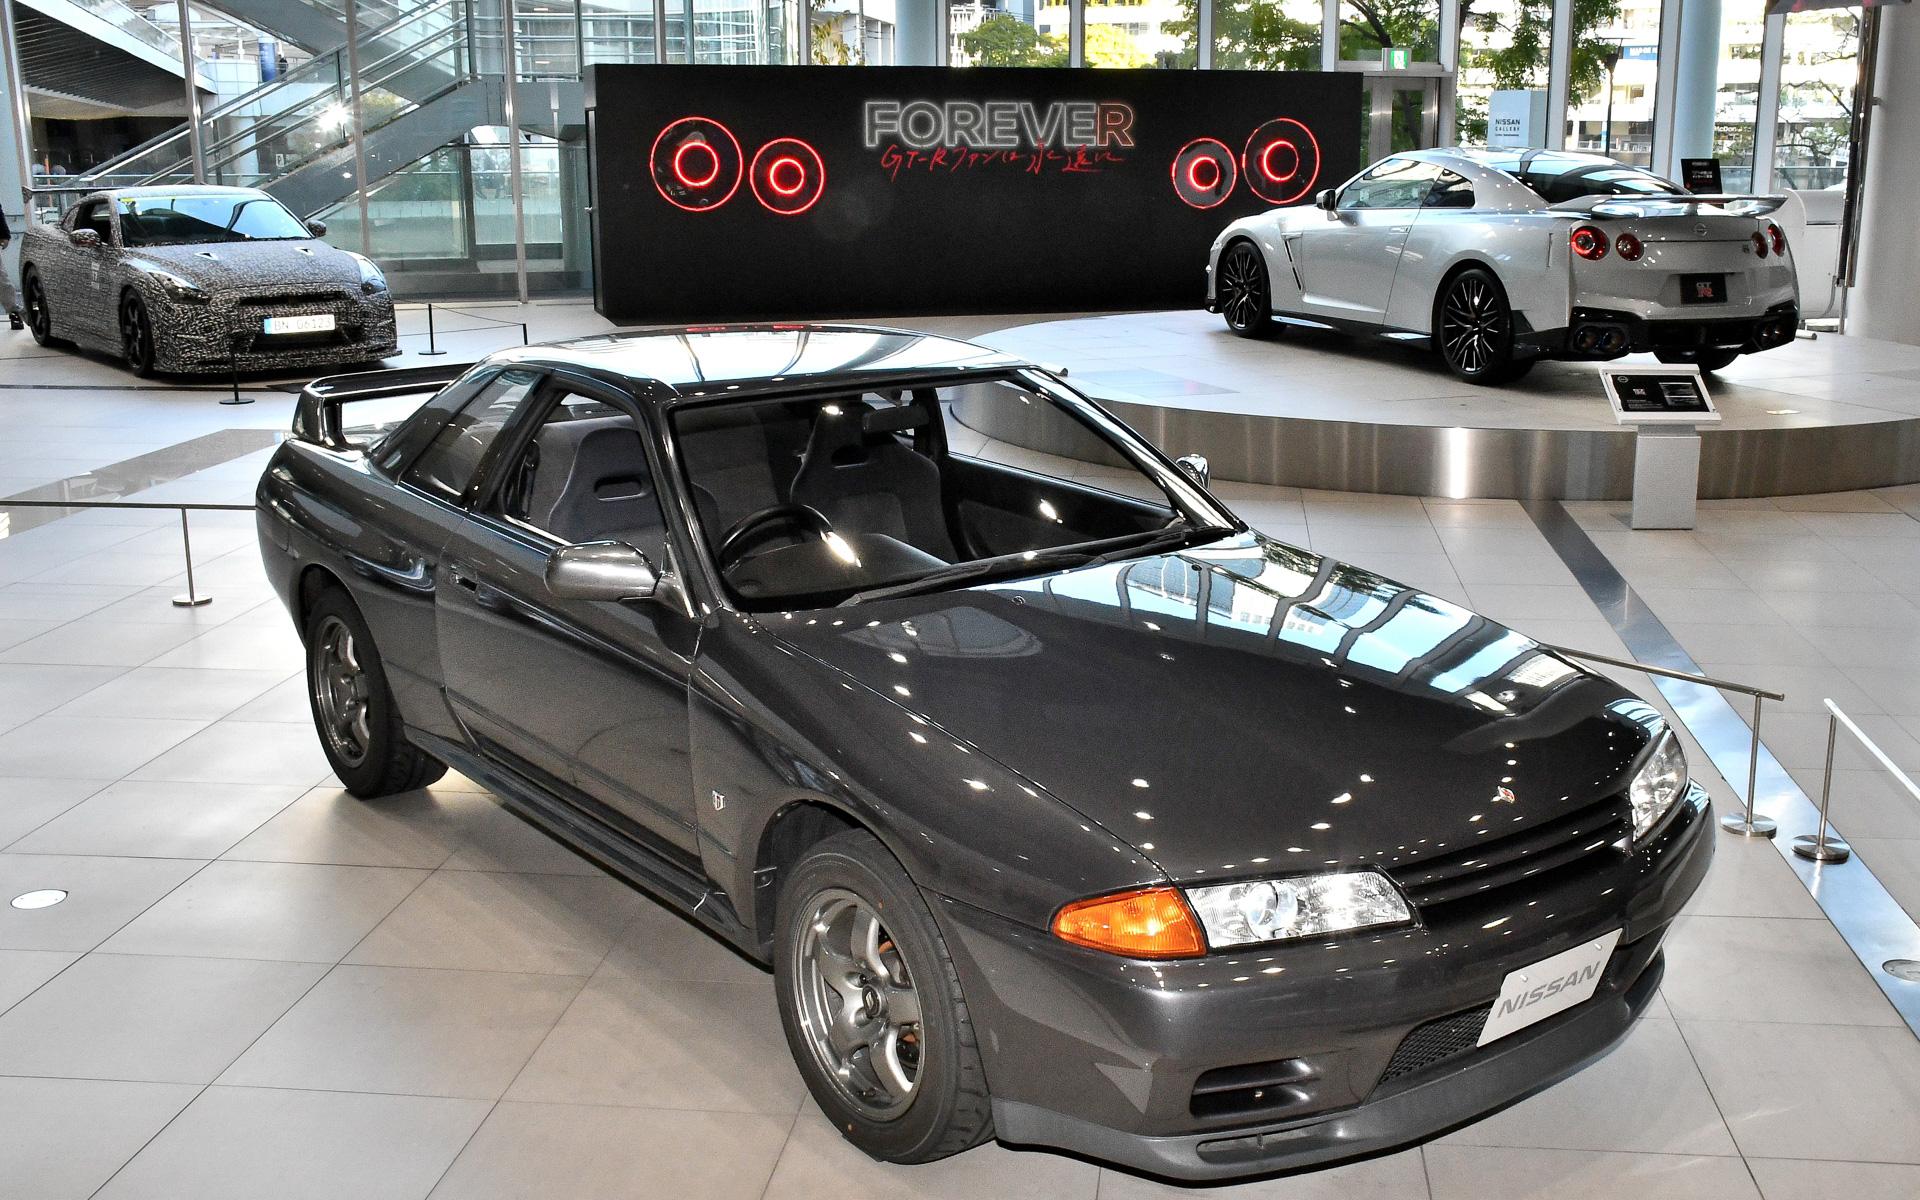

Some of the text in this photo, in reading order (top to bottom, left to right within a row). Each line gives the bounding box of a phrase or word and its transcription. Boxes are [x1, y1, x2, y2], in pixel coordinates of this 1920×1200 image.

[865, 101, 1135, 147] FOREVER
[274, 320, 289, 331] BN
[1497, 961, 1601, 1019] NISSAN
